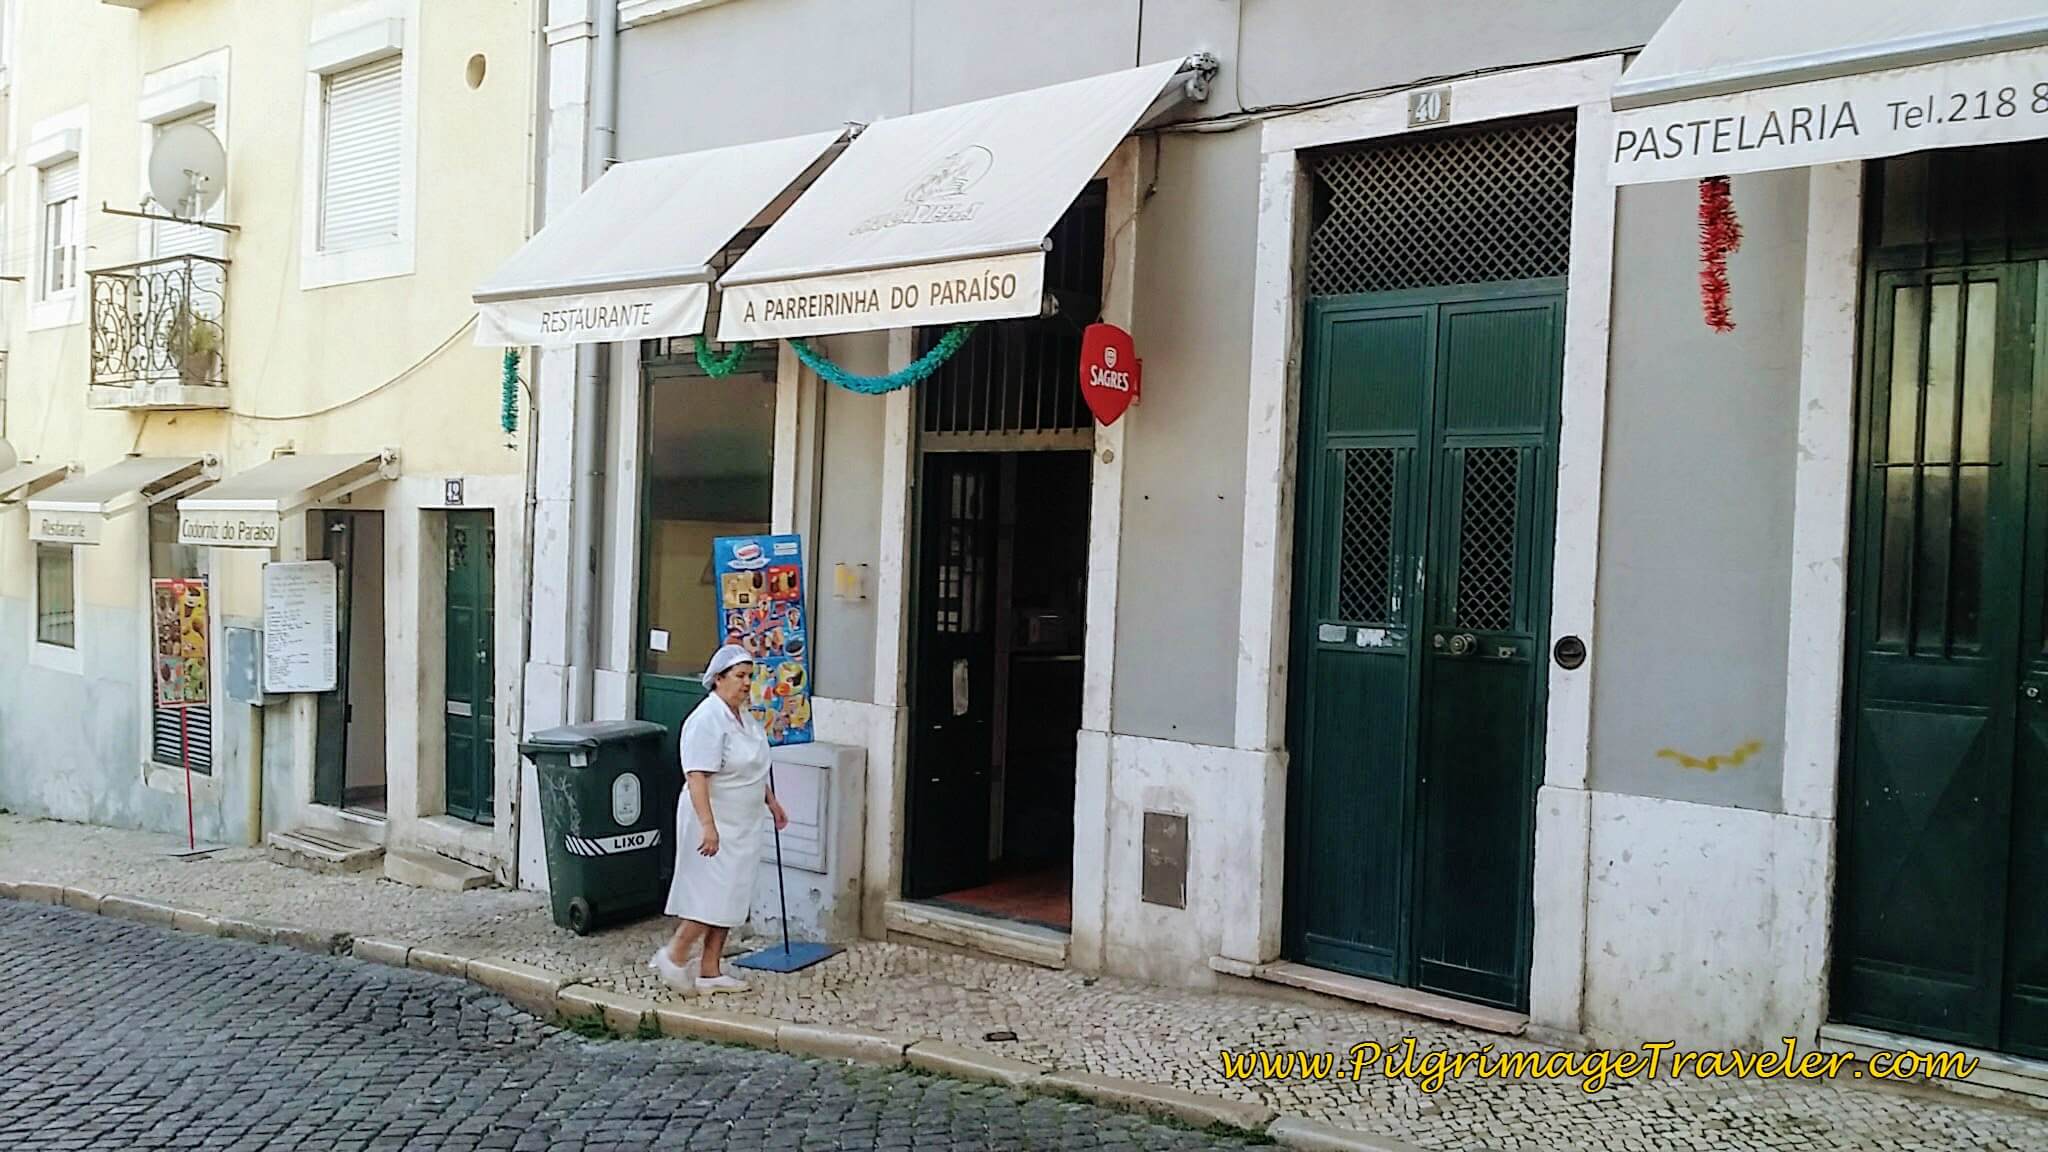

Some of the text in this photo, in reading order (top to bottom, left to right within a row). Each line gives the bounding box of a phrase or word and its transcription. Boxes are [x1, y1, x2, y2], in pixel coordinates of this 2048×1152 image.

[1415, 92, 1441, 121] 40
[1613, 100, 1860, 163] PASTELARIA
[1886, 86, 2016, 131] Tel.218
[744, 269, 1017, 323] A PARREIRINHA DO PARAÍSO
[540, 303, 653, 333] RESTAURANTE
[1090, 364, 1129, 392] SAGRES
[183, 519, 275, 541] Codorniz do Paraíso
[614, 834, 645, 849] LIXO
